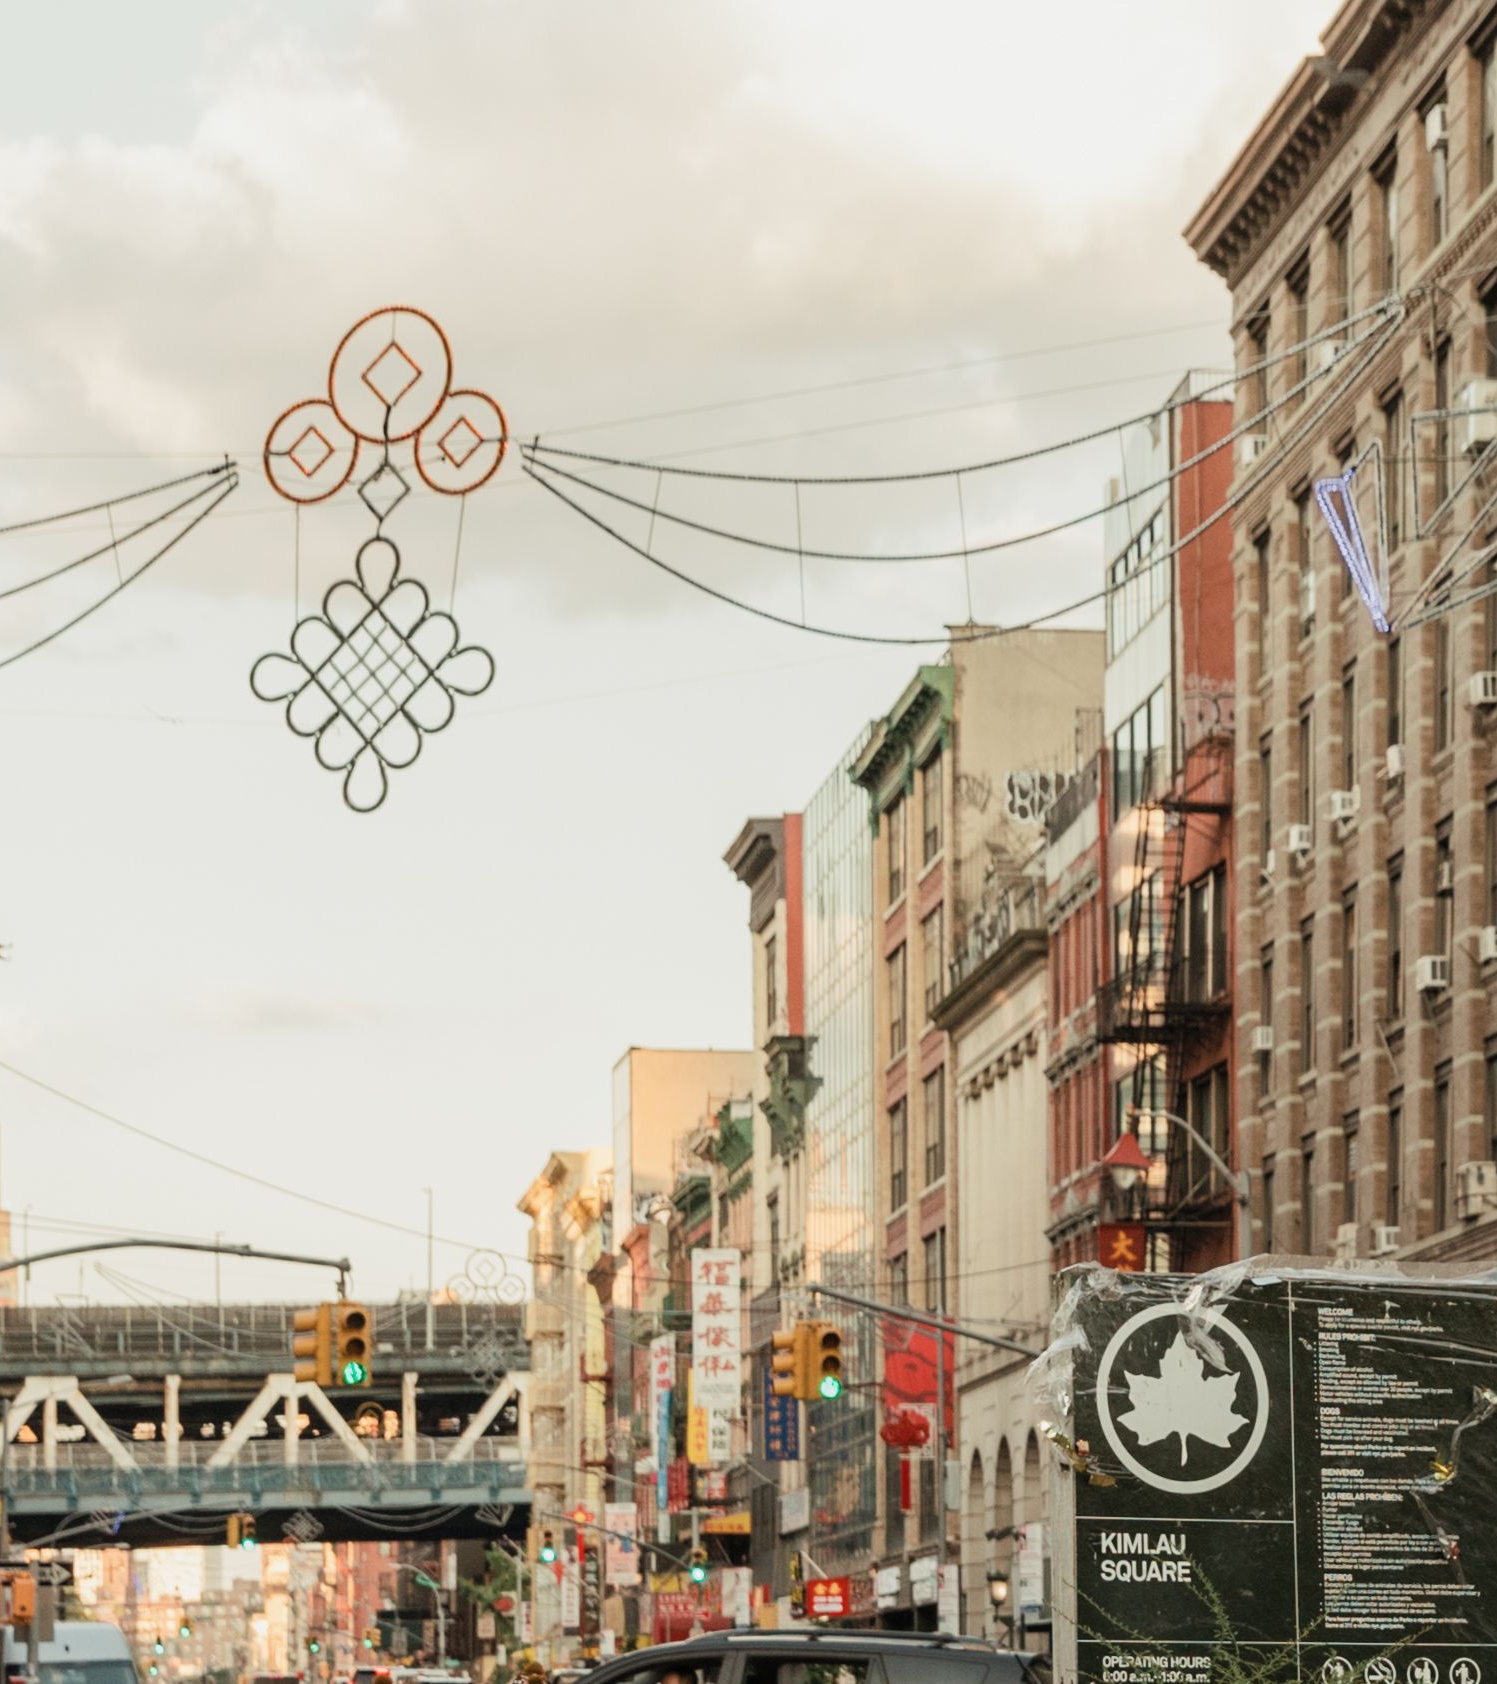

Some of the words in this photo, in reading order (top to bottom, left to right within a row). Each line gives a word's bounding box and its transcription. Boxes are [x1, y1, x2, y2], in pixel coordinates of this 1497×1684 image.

[1100, 1532, 1187, 1556] KIMLAU
[1100, 1559, 1192, 1583] SQUARE
[1170, 1656, 1212, 1669] HOURS
